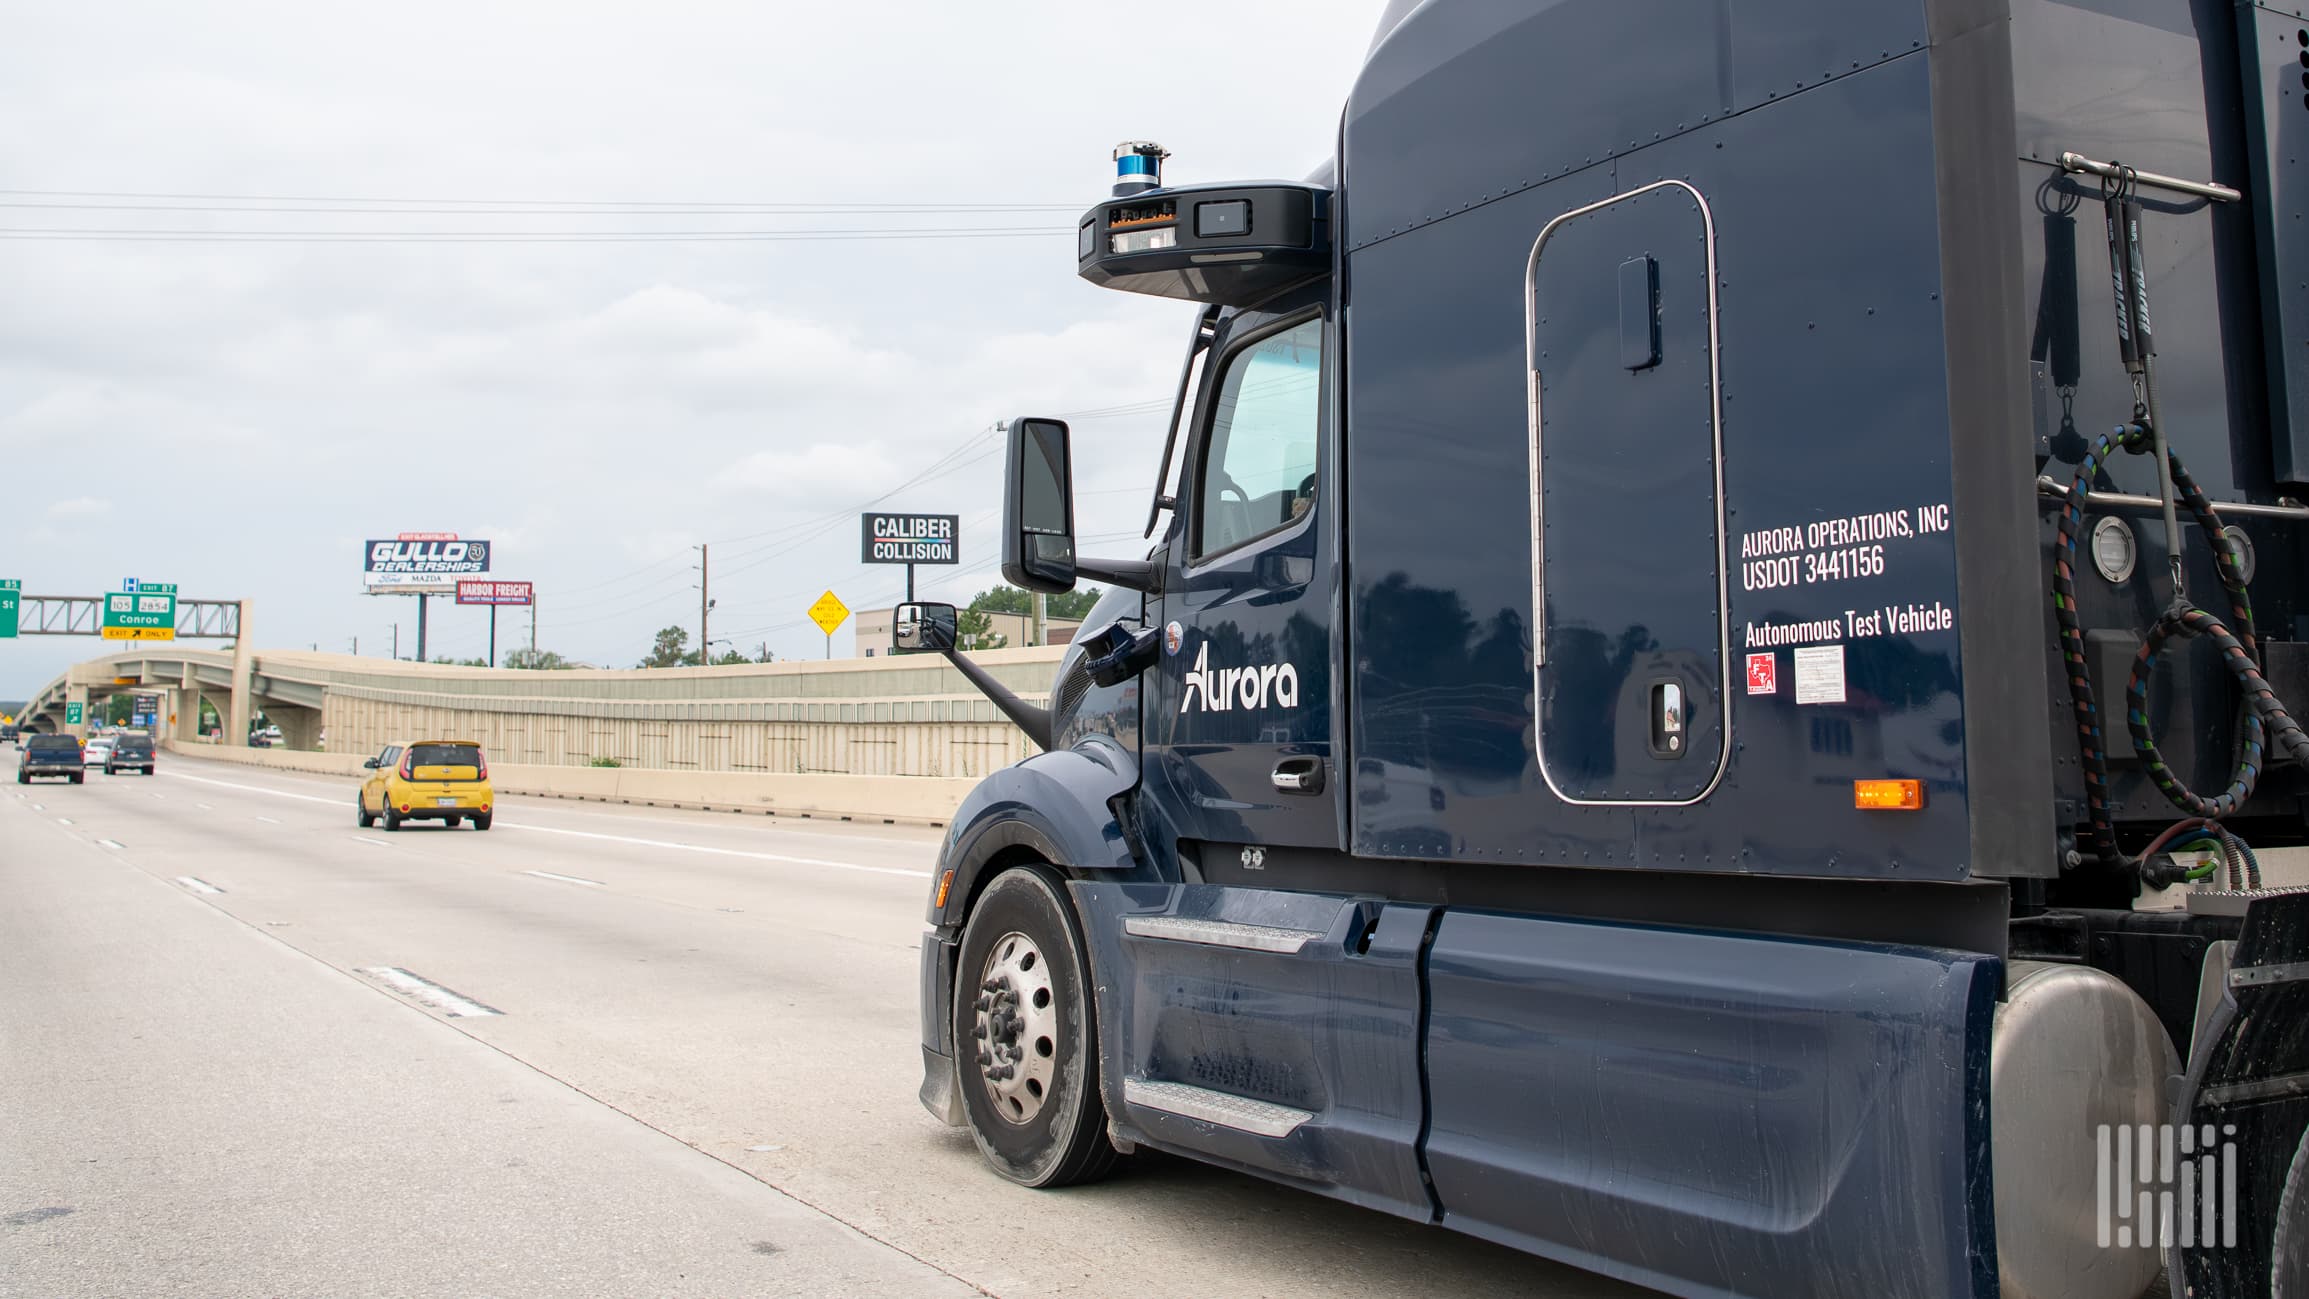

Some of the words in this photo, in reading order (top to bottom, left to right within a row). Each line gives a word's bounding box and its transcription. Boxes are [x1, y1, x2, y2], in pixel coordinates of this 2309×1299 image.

[2112, 271, 2129, 340] TRACKER
[2133, 269, 2151, 335] TRACKER
[874, 517, 951, 538] CALIBER
[1742, 525, 1804, 558] AURORA
[1808, 509, 1913, 549] OPERATIONS,
[1918, 504, 1950, 534] INC
[371, 542, 468, 562] GULLO
[873, 543, 952, 560] COLLISION
[372, 562, 483, 572] DEALERSHIPS
[1743, 556, 1800, 591] USDOT
[1805, 545, 1884, 583] 3441156
[162, 584, 174, 592] 87
[460, 583, 493, 596] HARBOR
[495, 583, 530, 597] FREIGHT
[2, 600, 14, 609] St
[113, 601, 130, 610] 105
[119, 614, 160, 625] Conroe
[1745, 618, 1841, 648] Autonomous
[1845, 610, 1882, 638] Test
[1886, 601, 1953, 635] Vehicle
[1180, 640, 1298, 713] Aurora
